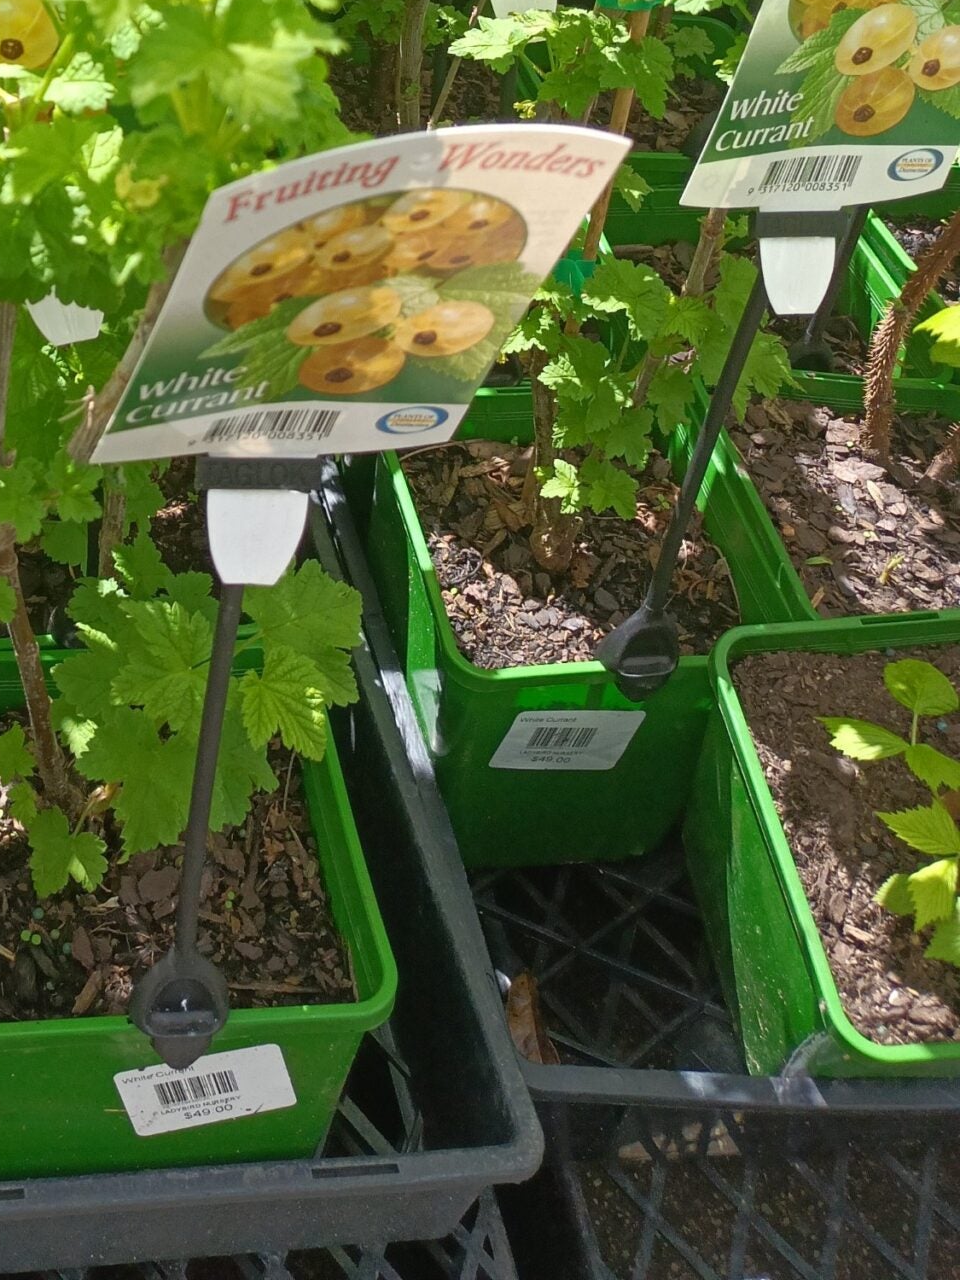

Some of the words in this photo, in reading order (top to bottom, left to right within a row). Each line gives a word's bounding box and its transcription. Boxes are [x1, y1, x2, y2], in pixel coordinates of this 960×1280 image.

[729, 88, 805, 121] White
[714, 116, 815, 152] Currant
[223, 155, 400, 221] Fruiting
[438, 142, 608, 179] Wonders
[139, 365, 249, 402] White
[125, 379, 270, 424] Currant
[121, 1073, 154, 1085] White
[160, 1102, 201, 1116] LADYBIRD
[183, 1103, 234, 1120] $49.00
